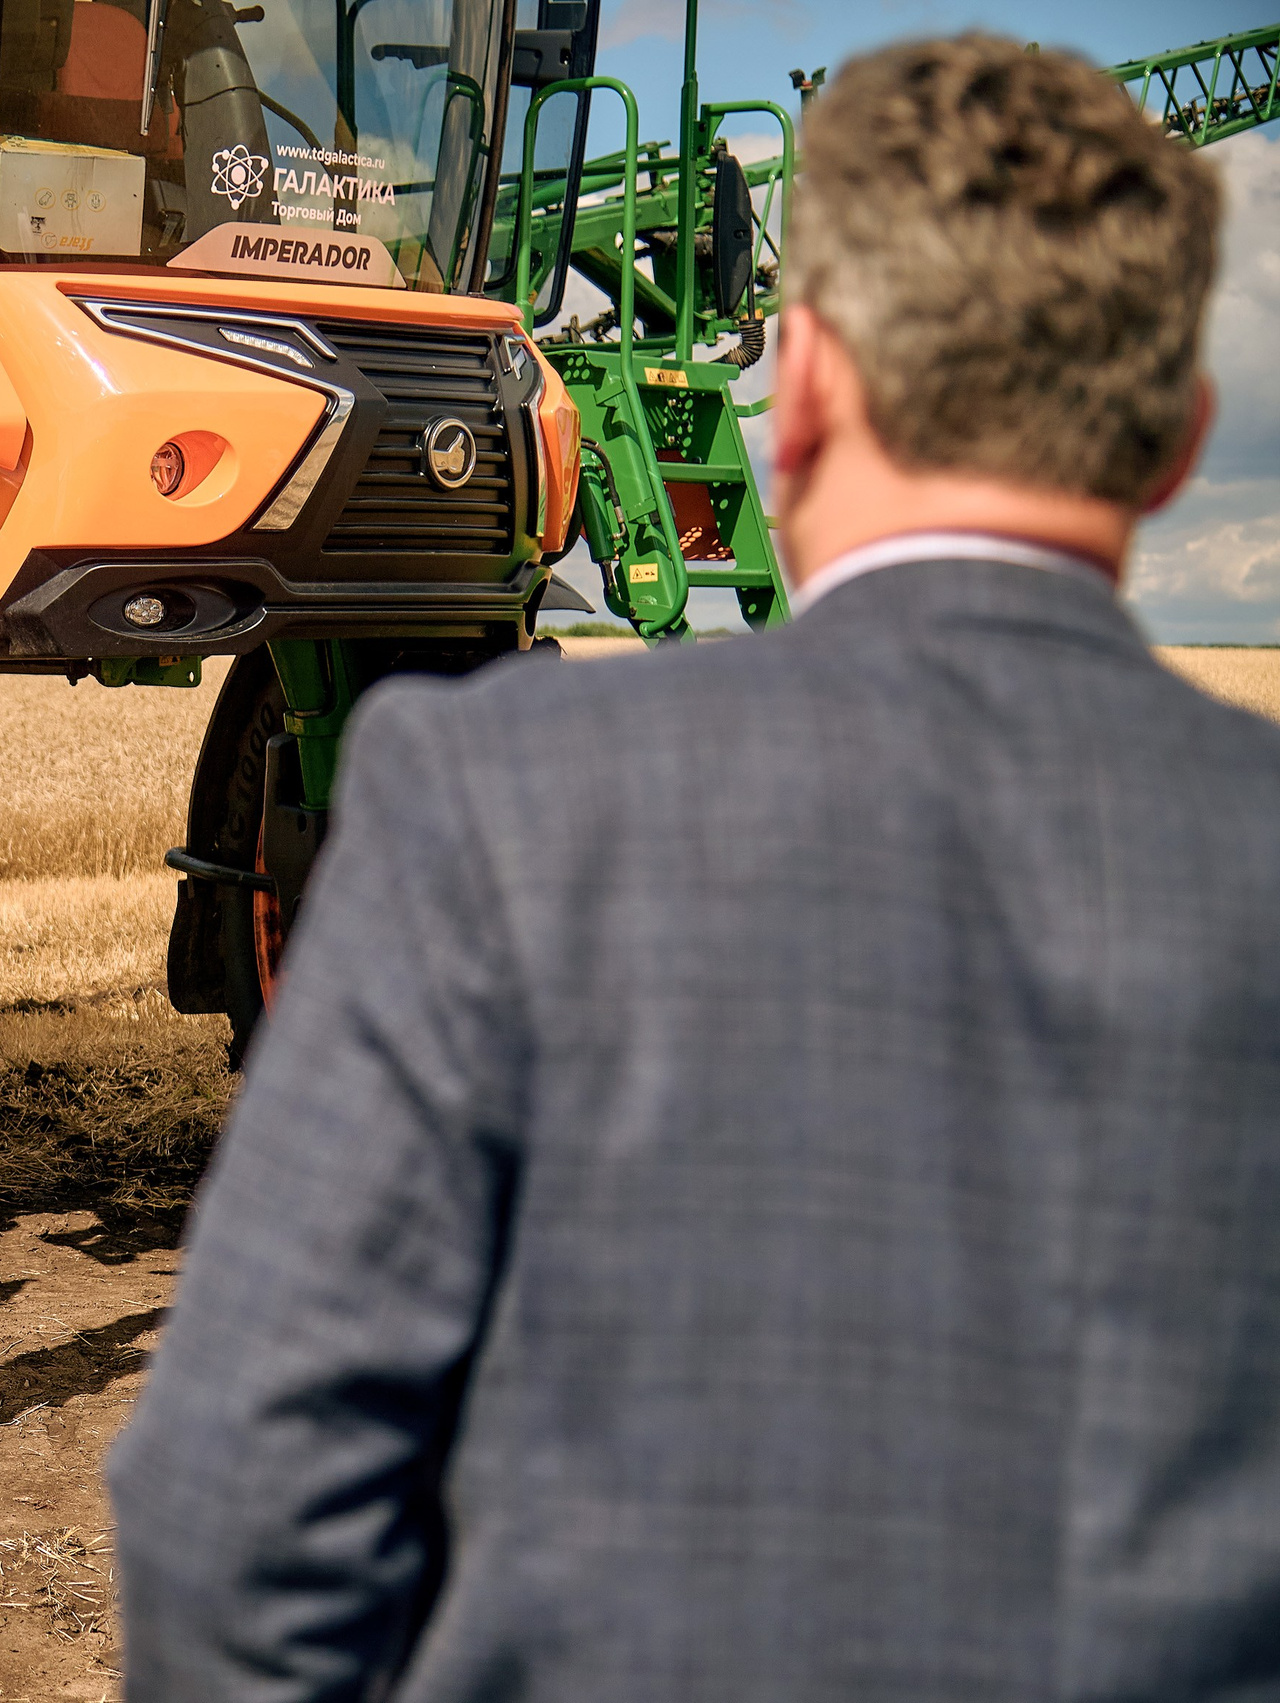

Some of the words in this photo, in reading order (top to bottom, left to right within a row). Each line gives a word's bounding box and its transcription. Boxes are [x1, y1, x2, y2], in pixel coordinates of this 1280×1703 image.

[276, 144, 385, 170] www.tdgalactica.ru
[273, 167, 396, 206] ГАЛАКТИКА
[272, 201, 334, 221] Торговый
[336, 209, 362, 226] Дом
[59, 236, 94, 251] Stara
[231, 235, 371, 270] IMPERADOR
